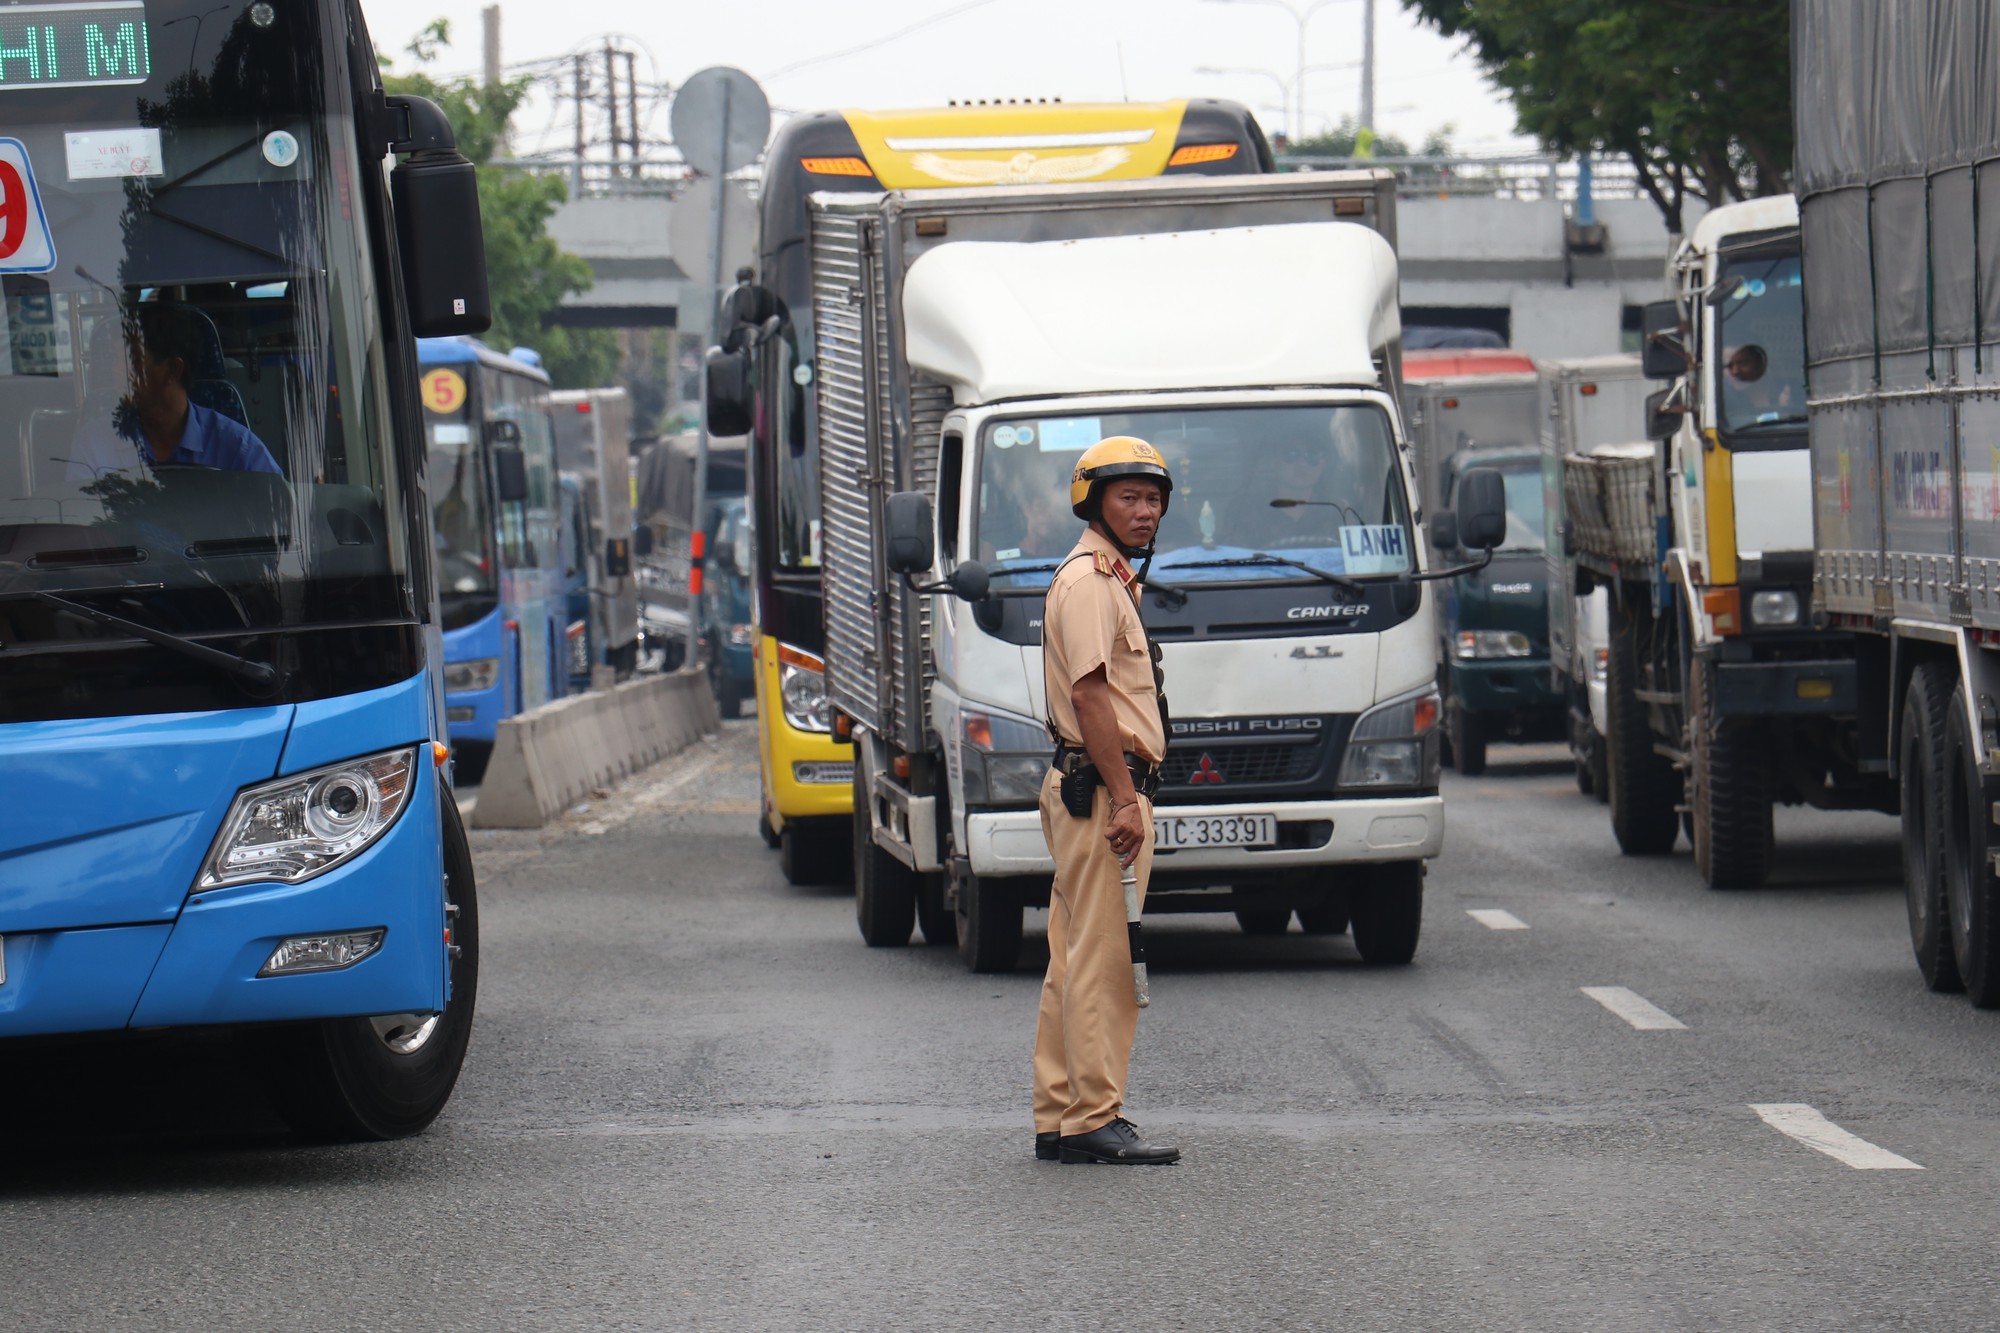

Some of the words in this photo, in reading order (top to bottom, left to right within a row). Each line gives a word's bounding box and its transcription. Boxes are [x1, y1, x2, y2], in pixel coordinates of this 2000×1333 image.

[433, 376, 454, 407] 5
[1287, 605, 1370, 619] CANTER
[1172, 720, 1240, 734] BISHI
[1250, 718, 1322, 731] FUSO
